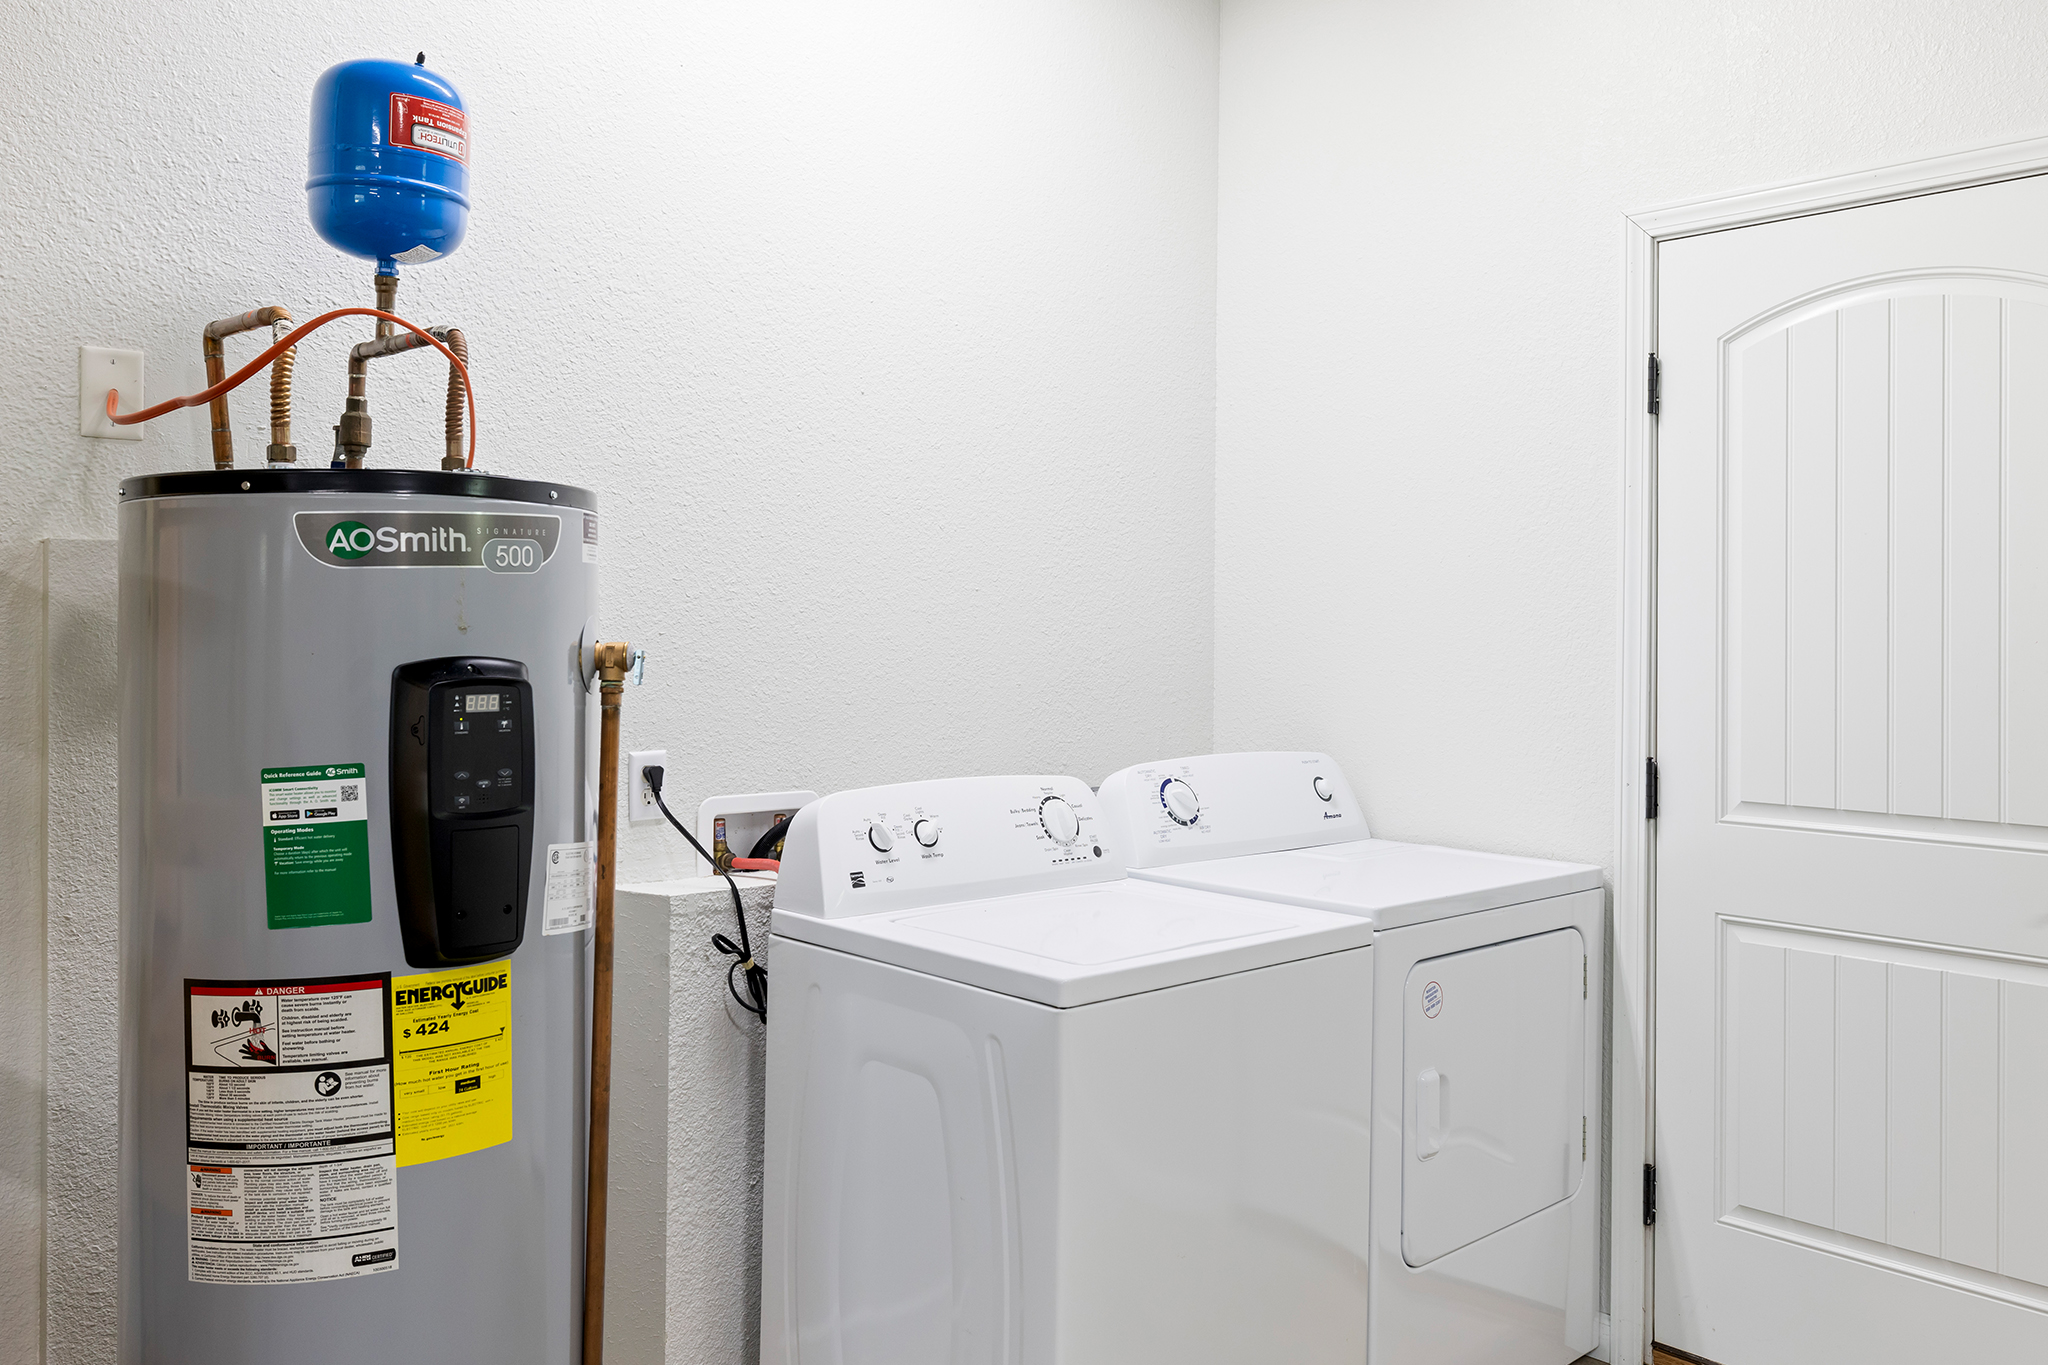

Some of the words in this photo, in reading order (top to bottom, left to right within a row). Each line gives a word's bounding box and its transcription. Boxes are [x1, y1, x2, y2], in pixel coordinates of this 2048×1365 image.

[412, 115, 435, 126] Tank
[437, 121, 467, 139] Expansion
[420, 132, 458, 149] UTILITECH
[476, 527, 546, 536] SIGNATURE
[495, 545, 533, 566] 500
[1324, 812, 1342, 820] Amana
[266, 987, 305, 995] DANGER
[395, 974, 507, 1006] ENERGYGUIDE
[403, 1029, 411, 1038] $
[416, 1020, 449, 1036] 424
[461, 1062, 480, 1070] Rating
[288, 1140, 331, 1149] IMPORTANTE
[372, 1252, 393, 1260] CERTIFIED
